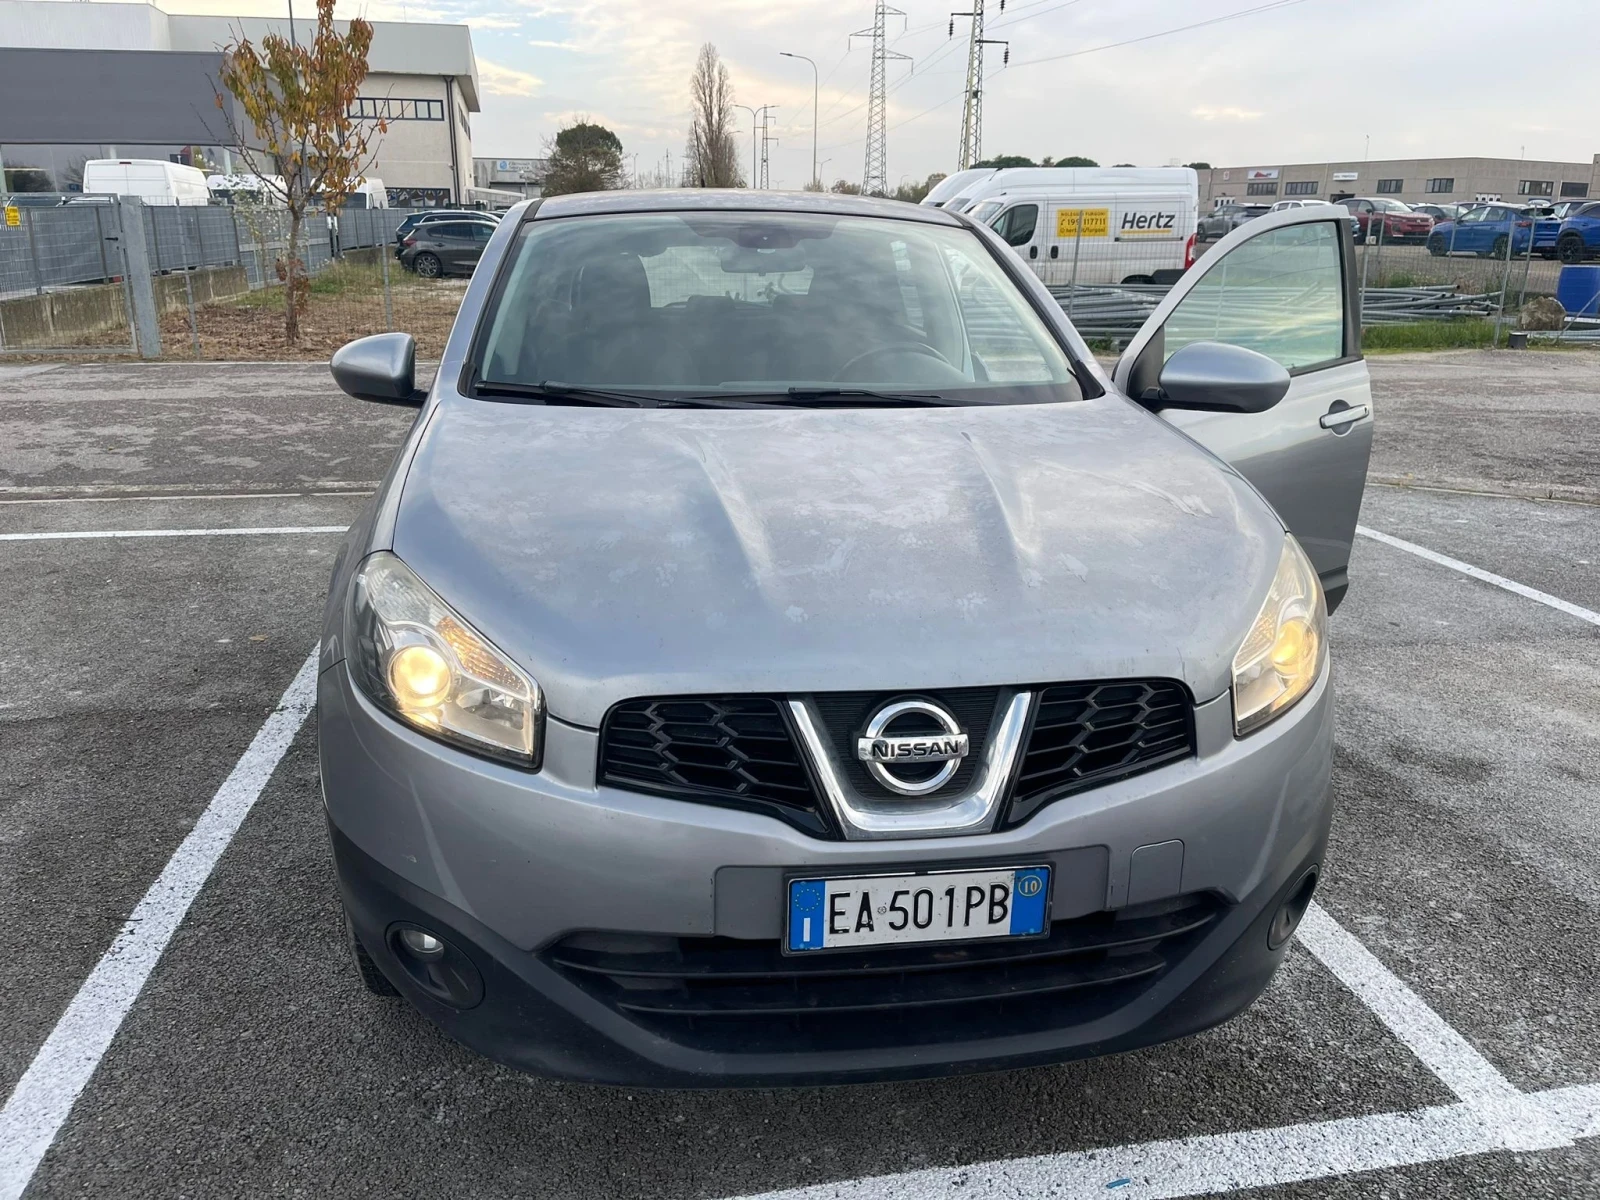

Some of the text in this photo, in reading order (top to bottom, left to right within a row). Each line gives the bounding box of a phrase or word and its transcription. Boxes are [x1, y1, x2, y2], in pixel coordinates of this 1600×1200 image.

[1083, 218, 1106, 226] 117711
[1121, 212, 1175, 230] Hertz
[872, 740, 960, 758] NISSAN
[803, 880, 1038, 942] I EA 501PB 10
